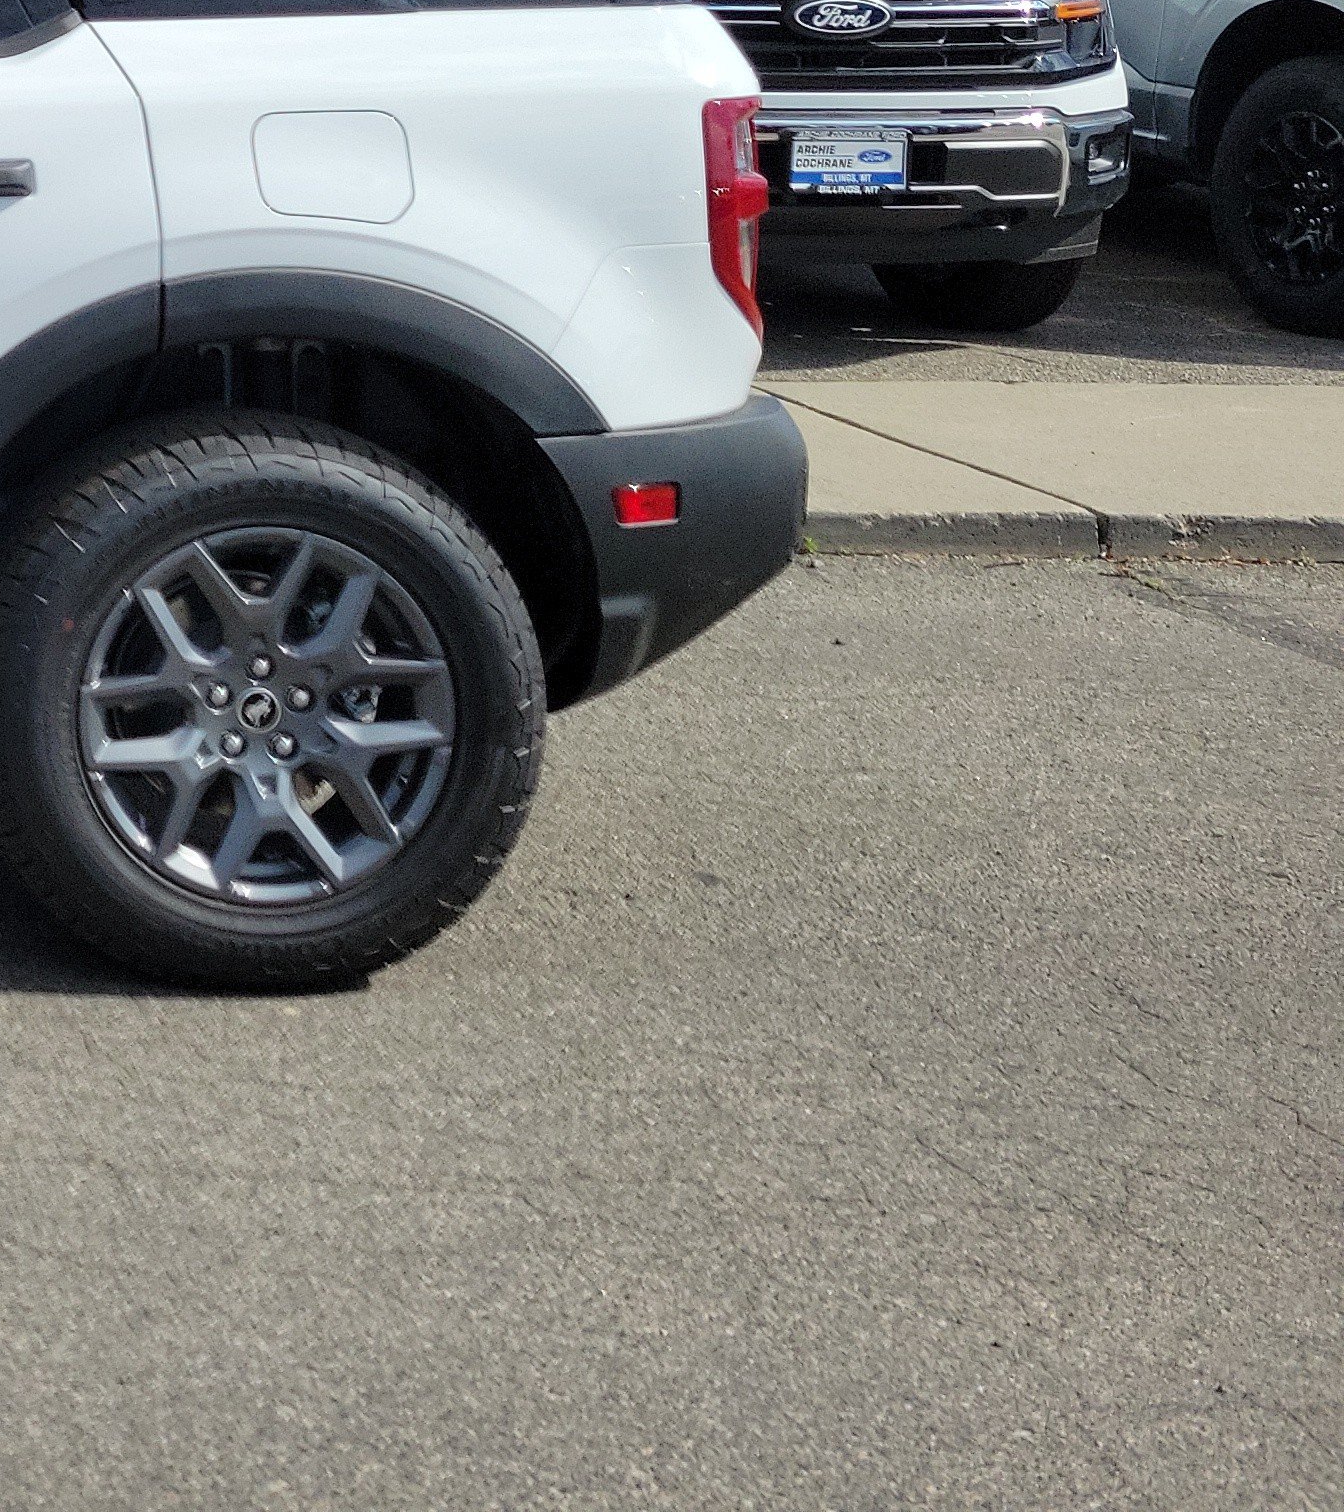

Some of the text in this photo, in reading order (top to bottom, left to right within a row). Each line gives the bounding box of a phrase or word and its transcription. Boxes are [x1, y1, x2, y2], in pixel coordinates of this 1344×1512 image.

[812, 3, 873, 28] Ford
[797, 144, 836, 155] ARCHIE
[862, 150, 886, 163] Ford
[795, 158, 853, 169] COCHRANE
